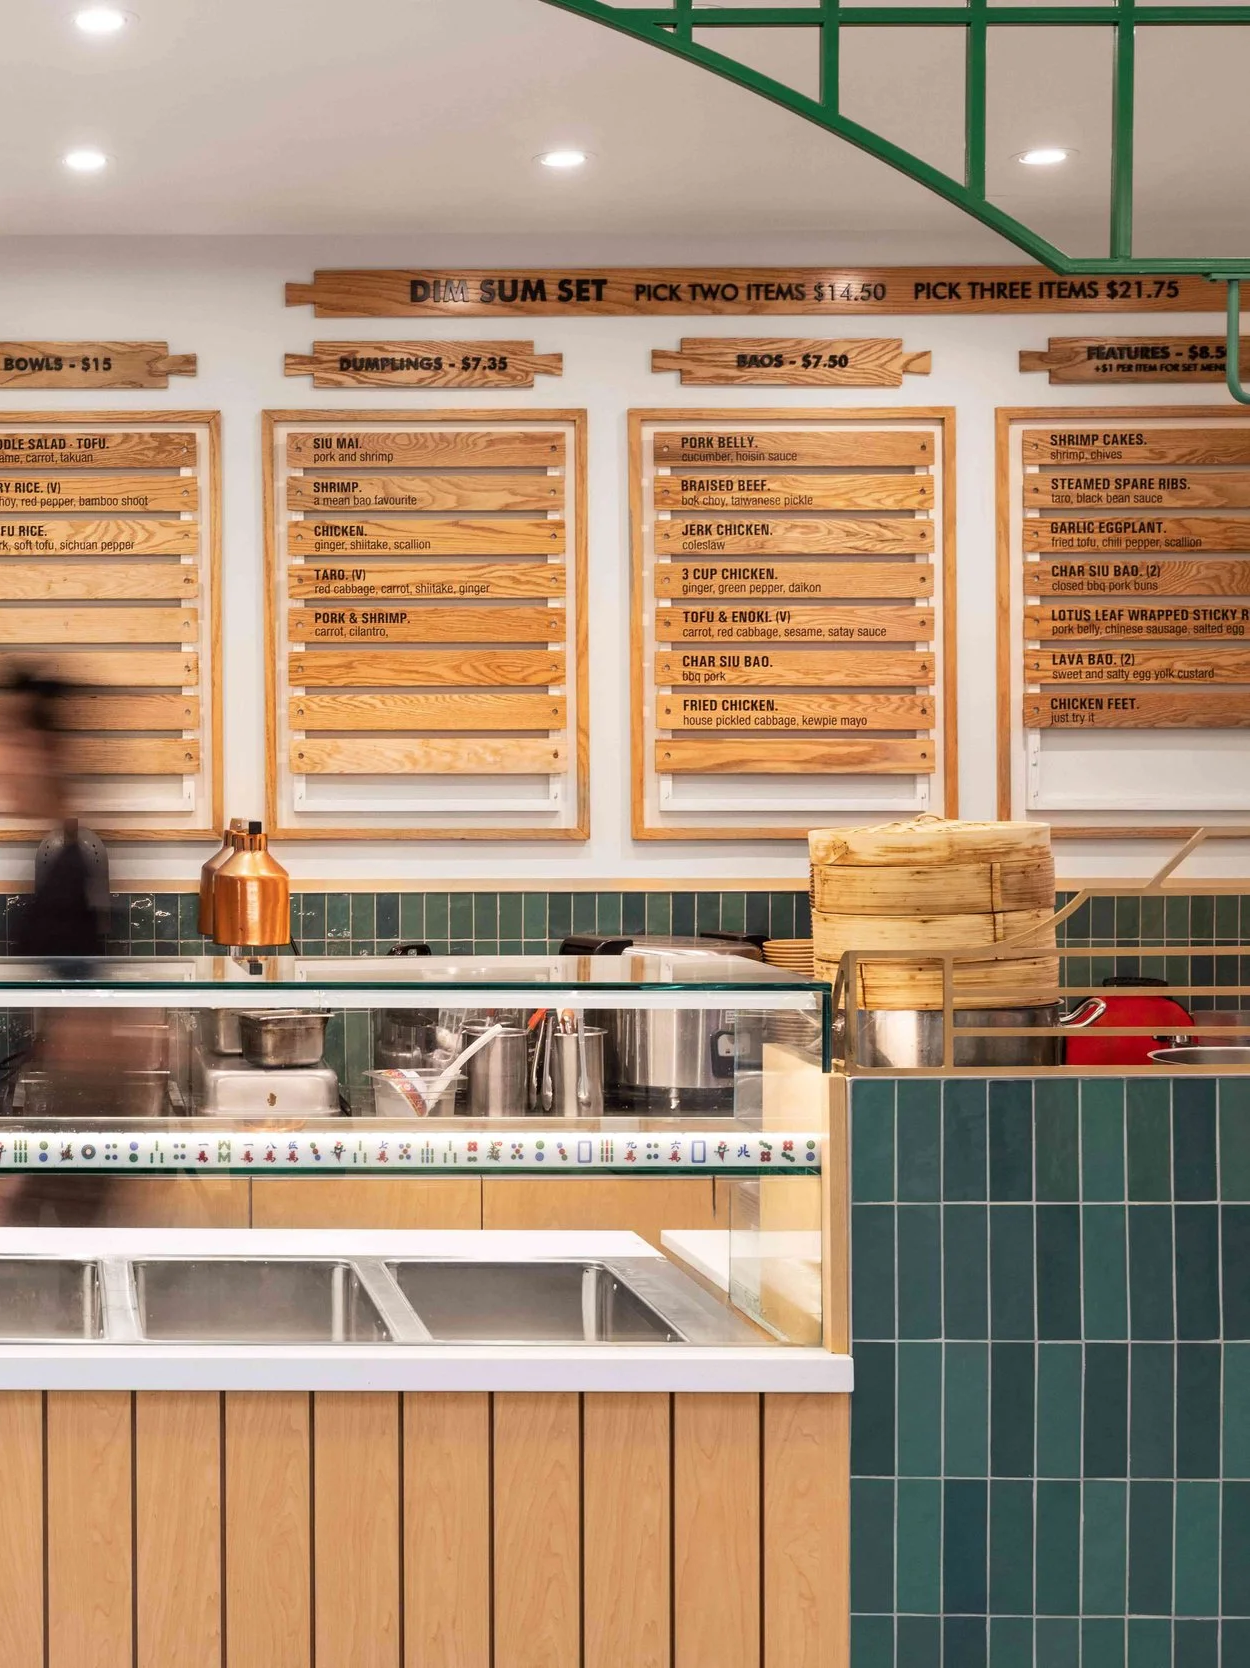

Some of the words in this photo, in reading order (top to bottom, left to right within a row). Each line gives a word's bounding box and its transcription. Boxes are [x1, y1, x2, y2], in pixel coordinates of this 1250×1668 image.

[410, 280, 469, 303] DIM
[480, 280, 546, 302] SUM
[557, 279, 607, 302] SET
[635, 284, 682, 301] PICK
[690, 284, 738, 301] TWO
[747, 283, 806, 301] ITEMS
[814, 282, 886, 302] $14.50
[914, 282, 962, 300] PICK
[970, 281, 1031, 299] THREE
[1039, 281, 1099, 299] ITEMS
[1106, 280, 1180, 299] $21.75
[1087, 345, 1170, 360] FEATURES
[1188, 345, 1227, 360] $8.5
[3, 358, 63, 372] BOWLS
[81, 358, 112, 372] $15
[340, 357, 442, 371] DUMPLINGS
[462, 357, 508, 371] $7.35
[737, 354, 784, 369] BAOS
[802, 354, 849, 369] $7.50
[1095, 364, 1112, 372] +$1
[1116, 364, 1133, 372] PER
[1135, 364, 1157, 372] ITEM
[1160, 364, 1179, 372] FOR
[1182, 364, 1198, 372] SET
[28, 438, 66, 450] SALAD
[77, 438, 110, 450] TOFU.
[313, 438, 332, 449] SIU
[336, 438, 362, 449] MAI.
[681, 437, 713, 449] PORK
[718, 437, 758, 449] BELLY.
[1050, 434, 1099, 446] SHRIMP
[1103, 434, 1147, 446] CAKES.
[26, 453, 57, 464] carrot,
[60, 452, 93, 463] takuan
[314, 452, 335, 464] pork
[338, 452, 357, 462] and
[360, 452, 393, 464] shrimp
[682, 450, 732, 463] cucumber,
[736, 450, 765, 461] hoisin
[768, 453, 797, 461] sauce
[1050, 449, 1088, 462] shrimp,
[1091, 449, 1122, 459] chives
[14, 483, 43, 494] RICE.
[47, 482, 61, 495] (V)
[313, 482, 362, 493] SHRIMP.
[681, 480, 733, 492] BRAISED
[738, 480, 770, 492] BEEF.
[1051, 478, 1110, 490] STEAMED
[1114, 478, 1154, 490] SPARE
[1158, 478, 1191, 490] RIBS.
[21, 496, 37, 506] red
[40, 498, 76, 509] pepper,
[79, 496, 118, 506] bamboo
[121, 496, 149, 506] shoot
[314, 497, 319, 505] a
[323, 497, 350, 505] mean
[353, 495, 371, 505] bao
[374, 495, 417, 505] favourite
[18, 526, 47, 537] RICE.
[314, 525, 367, 537] CHICKEN.
[682, 524, 712, 536] JERK
[716, 524, 773, 536] CHICKEN.
[1051, 522, 1094, 534] GARLIC
[1099, 522, 1167, 534] EGGPLANT.
[315, 539, 347, 552] ginger,
[350, 539, 391, 552] shiitake,
[394, 539, 431, 550] scallion
[682, 539, 725, 550] coleslaw
[314, 569, 348, 580] TARO.
[352, 569, 366, 581] (V)
[682, 568, 688, 580] 3
[693, 568, 717, 580] CUP
[721, 568, 778, 580] CHICKEN.
[315, 613, 345, 624] PORK
[349, 613, 358, 624] &
[361, 613, 410, 624] SHRIMP.
[683, 611, 714, 623] TOFU
[718, 611, 727, 623] &
[732, 611, 771, 623] ENOKI.
[775, 611, 791, 624] (V)
[1052, 609, 1091, 621] LOTUS
[1095, 609, 1124, 621] LEAF
[1128, 609, 1189, 621] WRAPPED
[1193, 609, 1238, 621] STICKY
[683, 627, 714, 639] carrot,
[717, 626, 734, 637] red
[737, 626, 781, 640] cabbage,
[784, 628, 825, 639] sesame,
[828, 627, 854, 640] satay
[857, 628, 887, 637] sauce
[1052, 623, 1073, 636] pork
[1077, 623, 1102, 636] belly,
[1105, 623, 1144, 633] chinese
[1147, 625, 1191, 636] sausage,
[1193, 623, 1224, 633] salted
[1228, 625, 1245, 636] egg
[682, 656, 715, 667] CHAR
[719, 656, 739, 667] SIU
[744, 656, 773, 667] BAO.
[1052, 653, 1083, 666] LAVA
[1088, 653, 1117, 666] BAO.
[1120, 653, 1135, 667] (2)
[682, 670, 701, 683] bbq
[704, 670, 726, 683] pork
[1052, 669, 1083, 678] sweet
[1085, 668, 1103, 678] and
[1106, 668, 1130, 681] salty
[1133, 670, 1151, 681] egg
[1154, 668, 1174, 681] yolk
[1177, 668, 1214, 678] custard
[683, 699, 717, 711] FRIED
[722, 699, 778, 711] CHICKEN.
[1050, 698, 1104, 710] CHICKEN
[1108, 698, 1139, 710] FEET.
[1051, 713, 1069, 725] just
[1071, 713, 1085, 725] try
[1087, 712, 1094, 723] it
